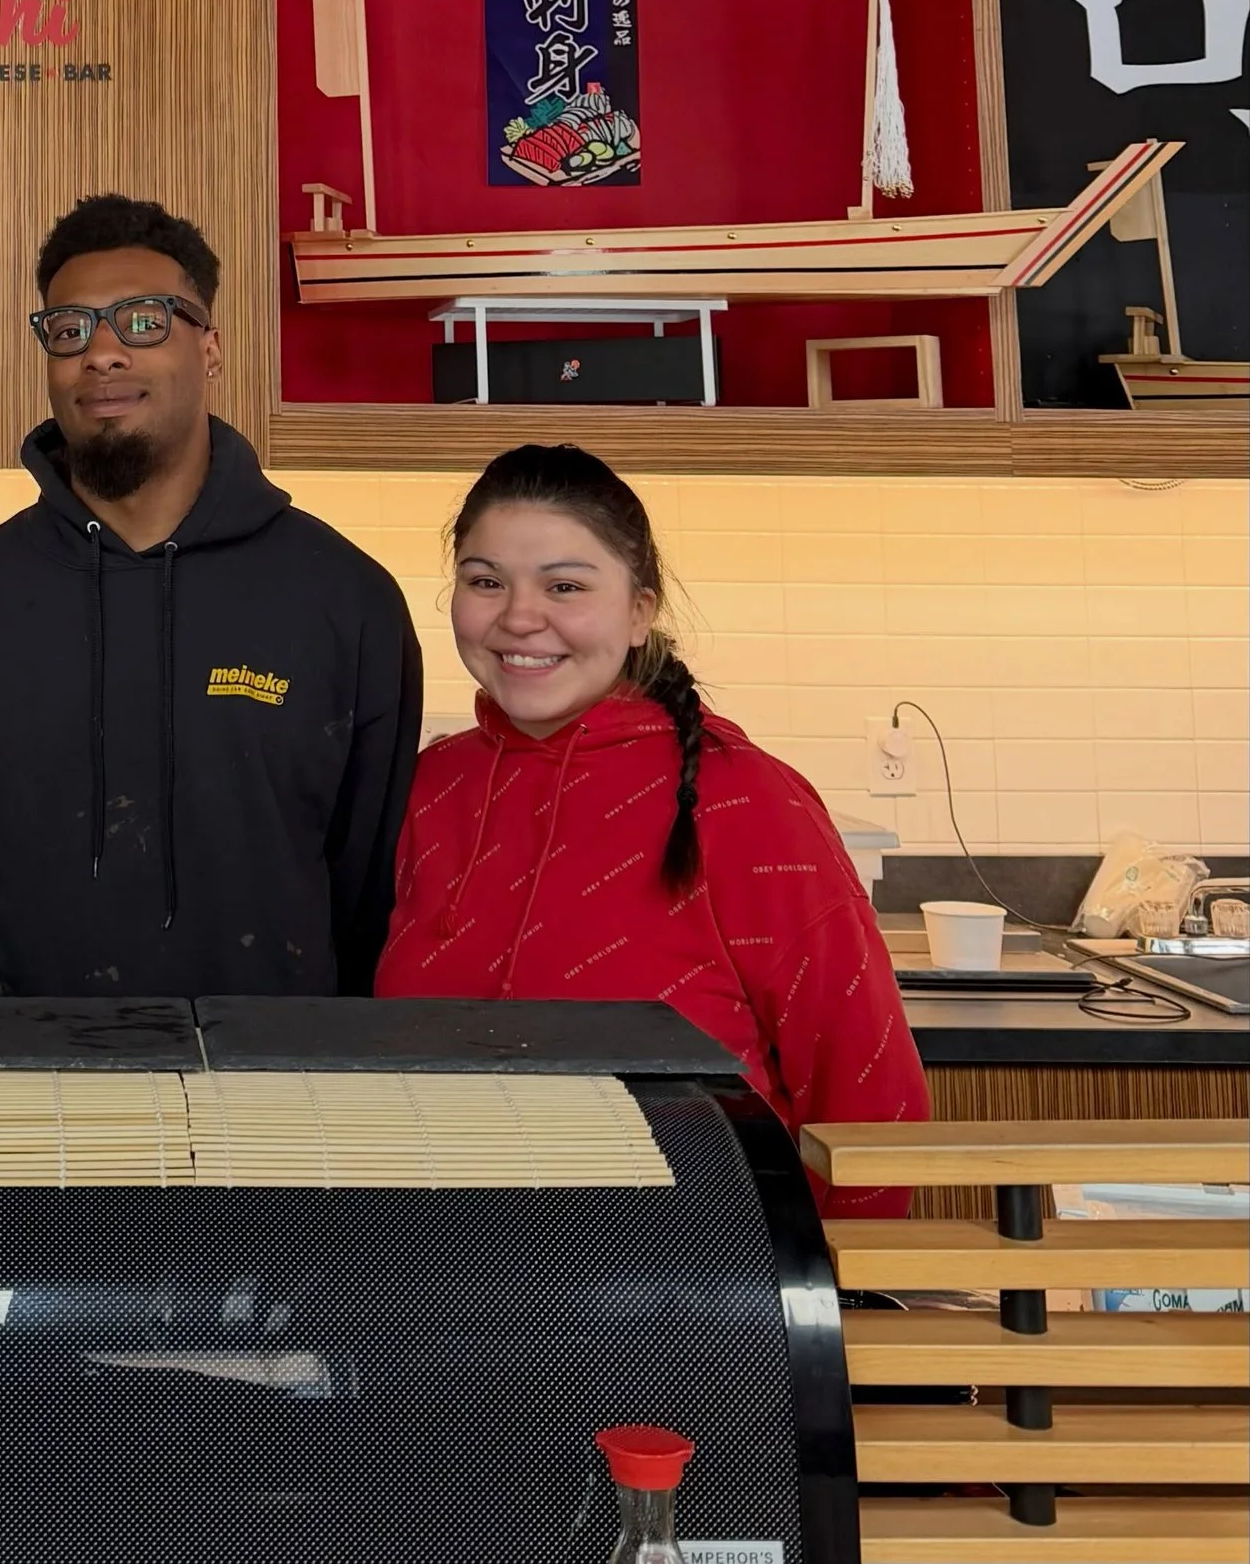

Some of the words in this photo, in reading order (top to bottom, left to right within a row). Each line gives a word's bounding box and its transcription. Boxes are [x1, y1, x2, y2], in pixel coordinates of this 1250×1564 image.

[63, 63, 112, 81] BAR
[209, 664, 289, 694] meineke
[1153, 1289, 1190, 1312] GOMA
